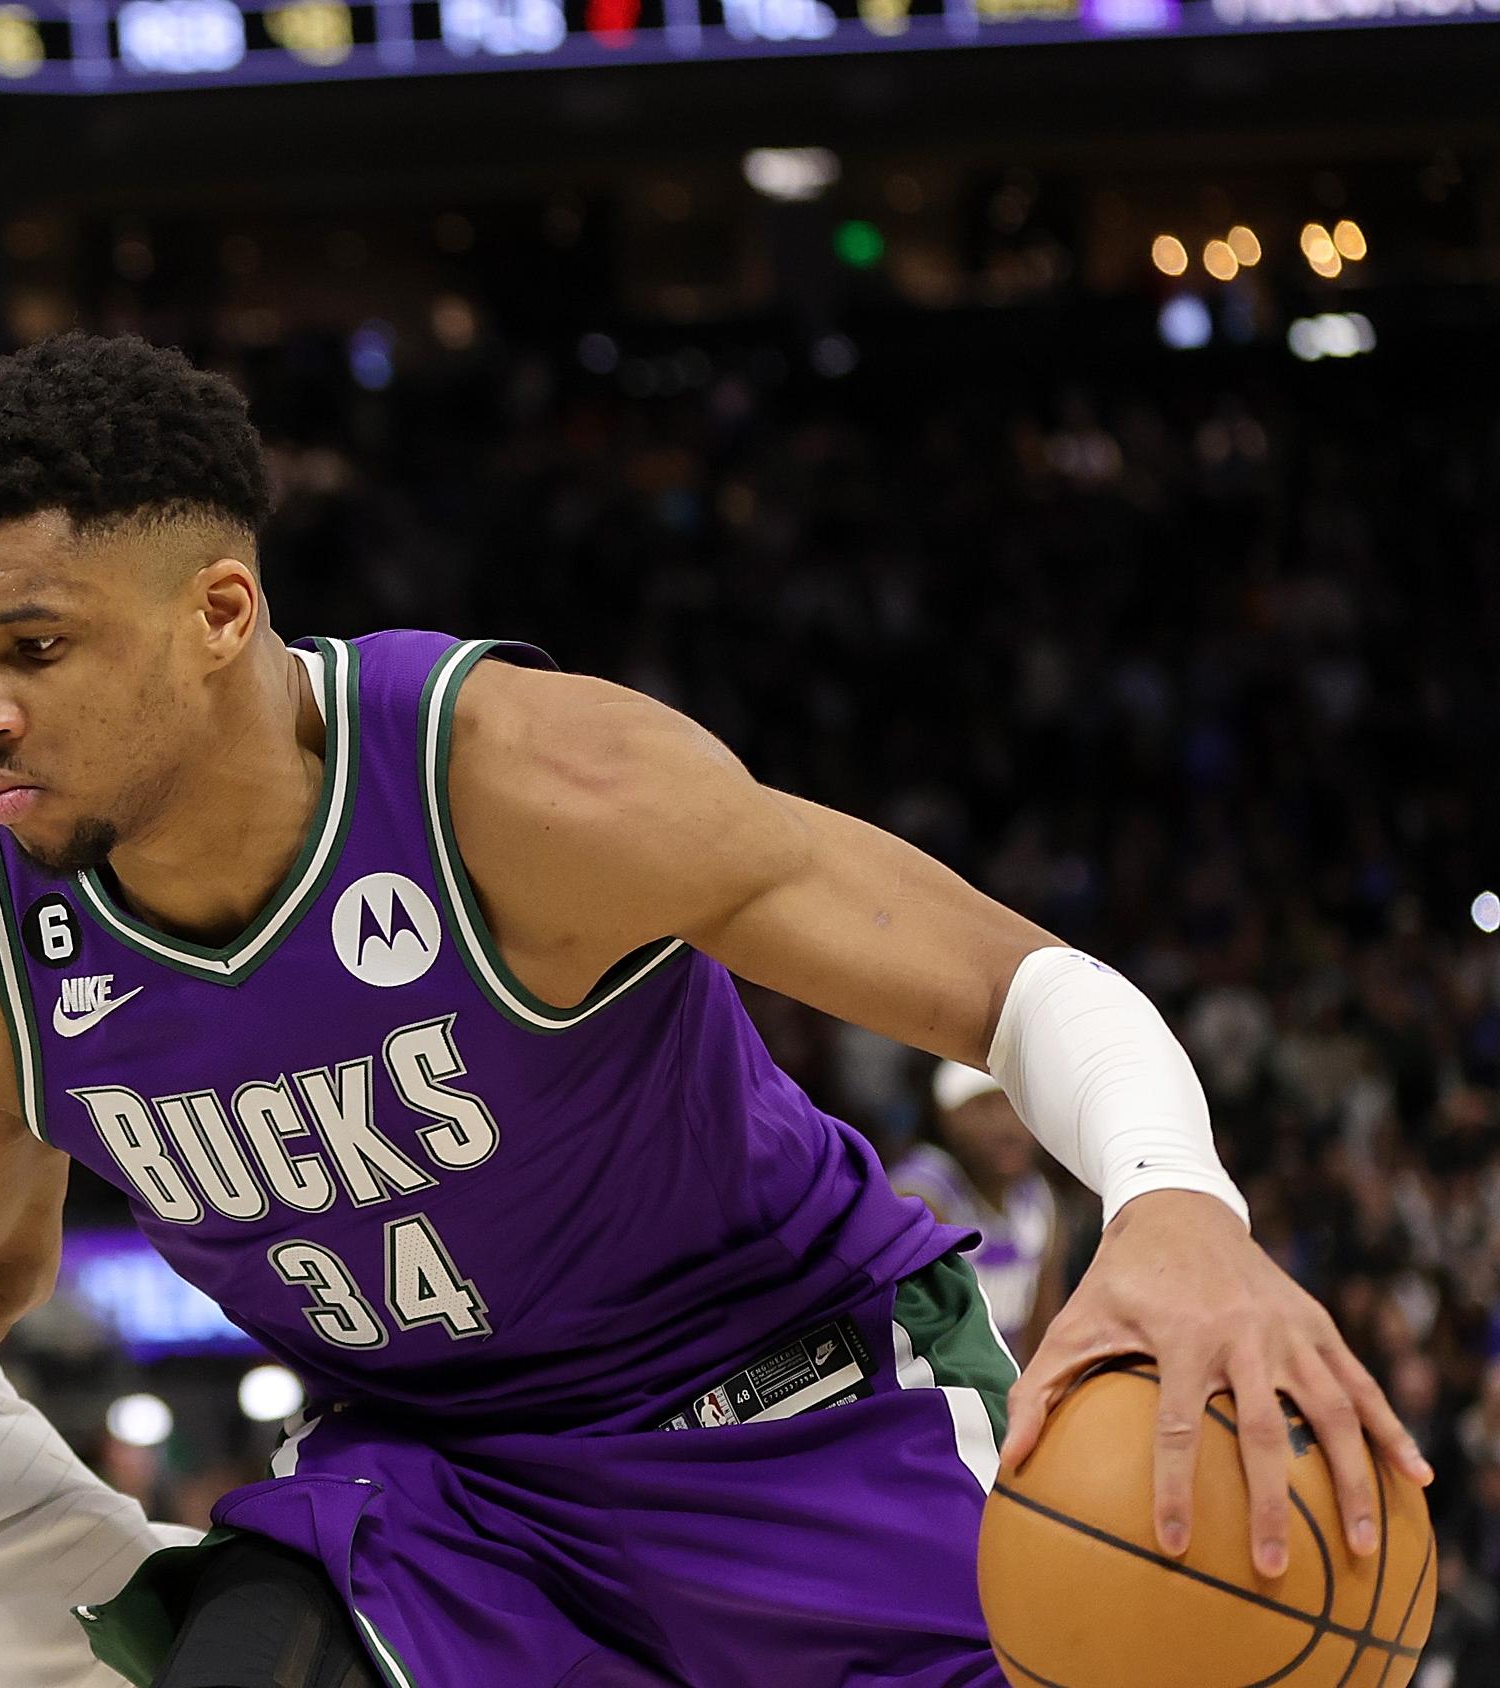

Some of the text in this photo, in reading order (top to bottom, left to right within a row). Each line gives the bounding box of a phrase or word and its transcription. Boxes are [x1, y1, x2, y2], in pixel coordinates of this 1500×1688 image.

[38, 904, 73, 960] 6
[60, 974, 115, 1013] NIKE
[65, 1012, 500, 1225] BUCKS
[267, 1212, 493, 1350] 34
[736, 1389, 751, 1404] 48
